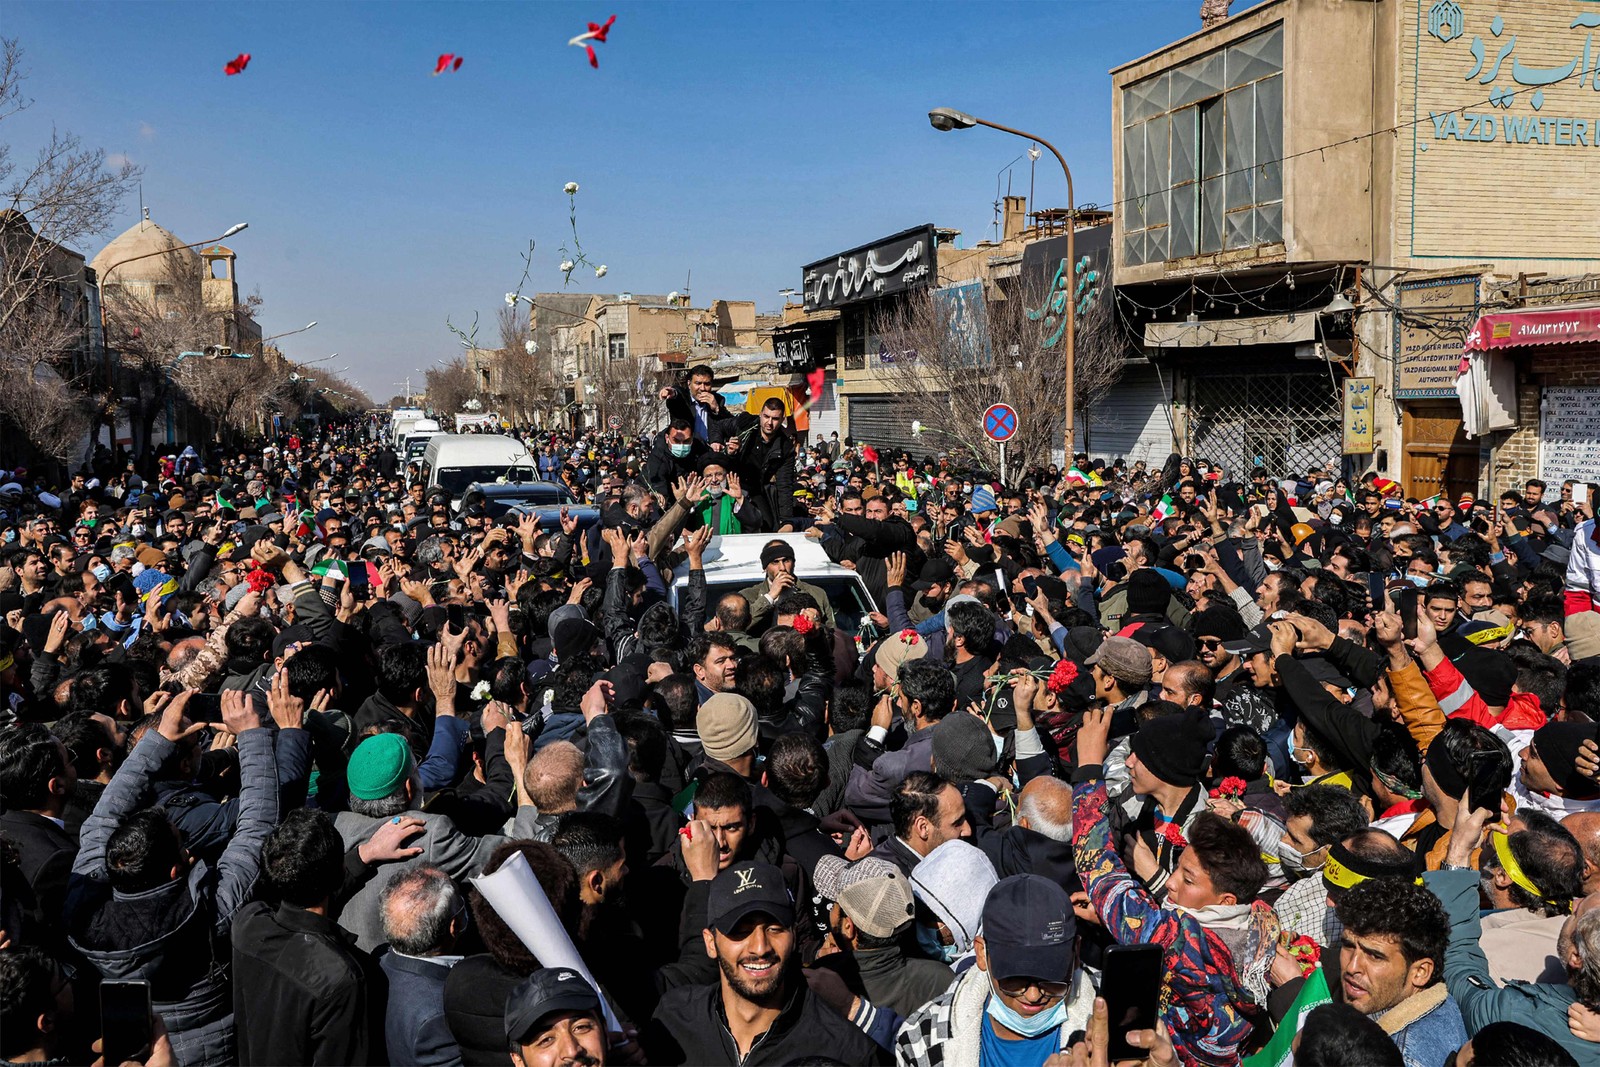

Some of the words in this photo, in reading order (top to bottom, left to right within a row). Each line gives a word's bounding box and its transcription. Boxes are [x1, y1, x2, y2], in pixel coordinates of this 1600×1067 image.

[1465, 15, 1517, 109] یزد
[1429, 111, 1497, 142] YAZD
[1503, 115, 1588, 146] WATER
[1404, 366, 1418, 374] YAZD
[1350, 381, 1370, 393] موزه
[1352, 396, 1368, 414] آب
[1352, 419, 1367, 434] یزد
